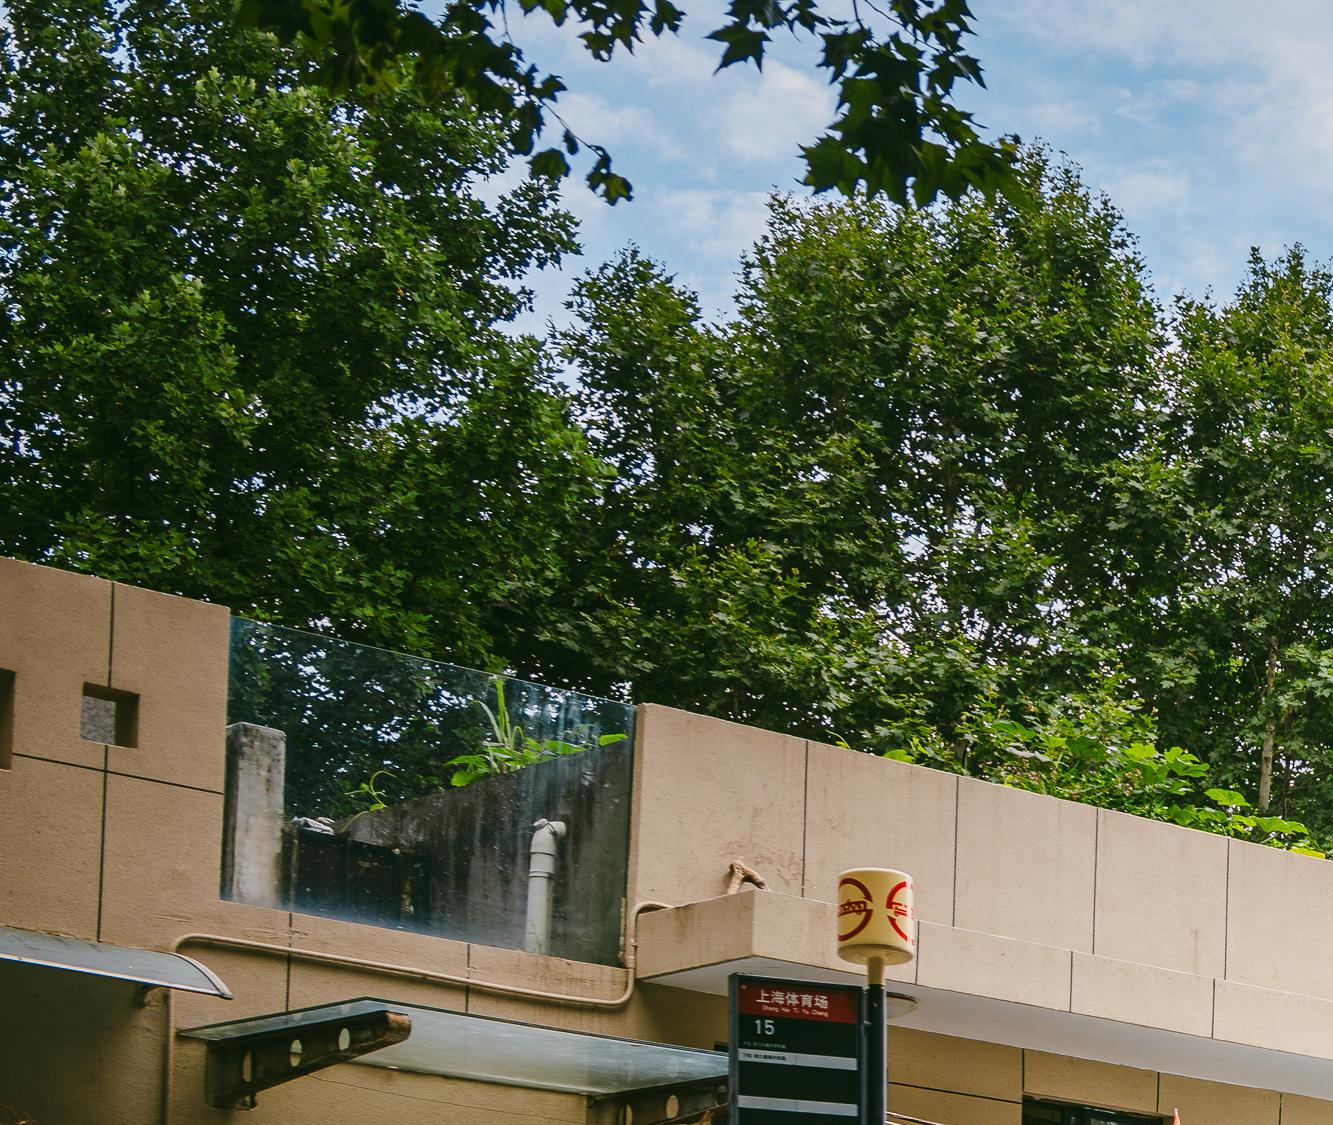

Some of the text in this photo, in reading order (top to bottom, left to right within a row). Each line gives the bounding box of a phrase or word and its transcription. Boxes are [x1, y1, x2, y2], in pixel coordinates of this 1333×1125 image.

[755, 989, 829, 1009] 上海体育场
[754, 1019, 775, 1035] 15
